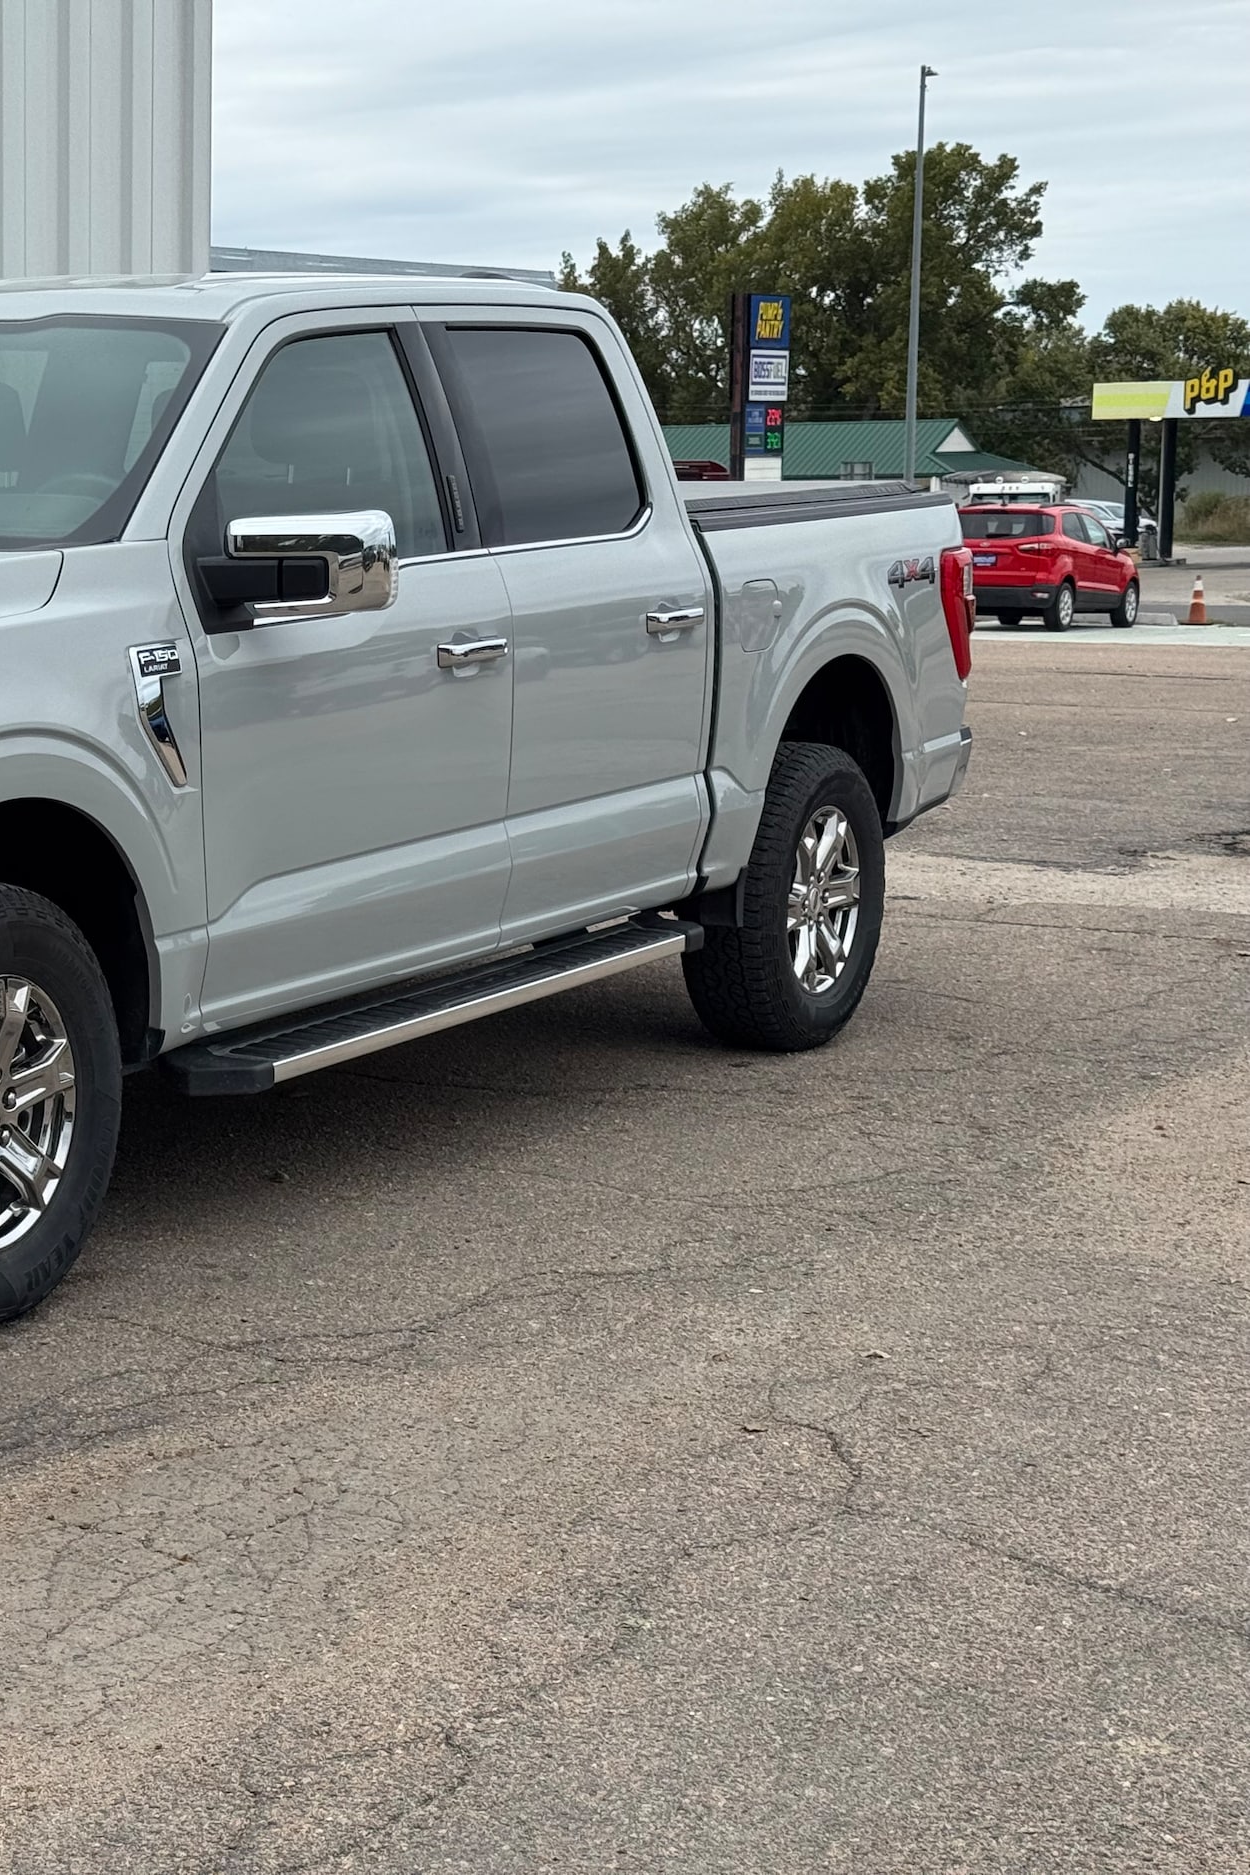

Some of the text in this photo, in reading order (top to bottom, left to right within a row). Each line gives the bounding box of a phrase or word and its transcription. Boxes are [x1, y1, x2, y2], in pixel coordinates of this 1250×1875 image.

[755, 316, 784, 340] PANTRY
[1184, 367, 1234, 411] P&P
[138, 649, 178, 664] F-150
[143, 663, 168, 672] LARIAT
